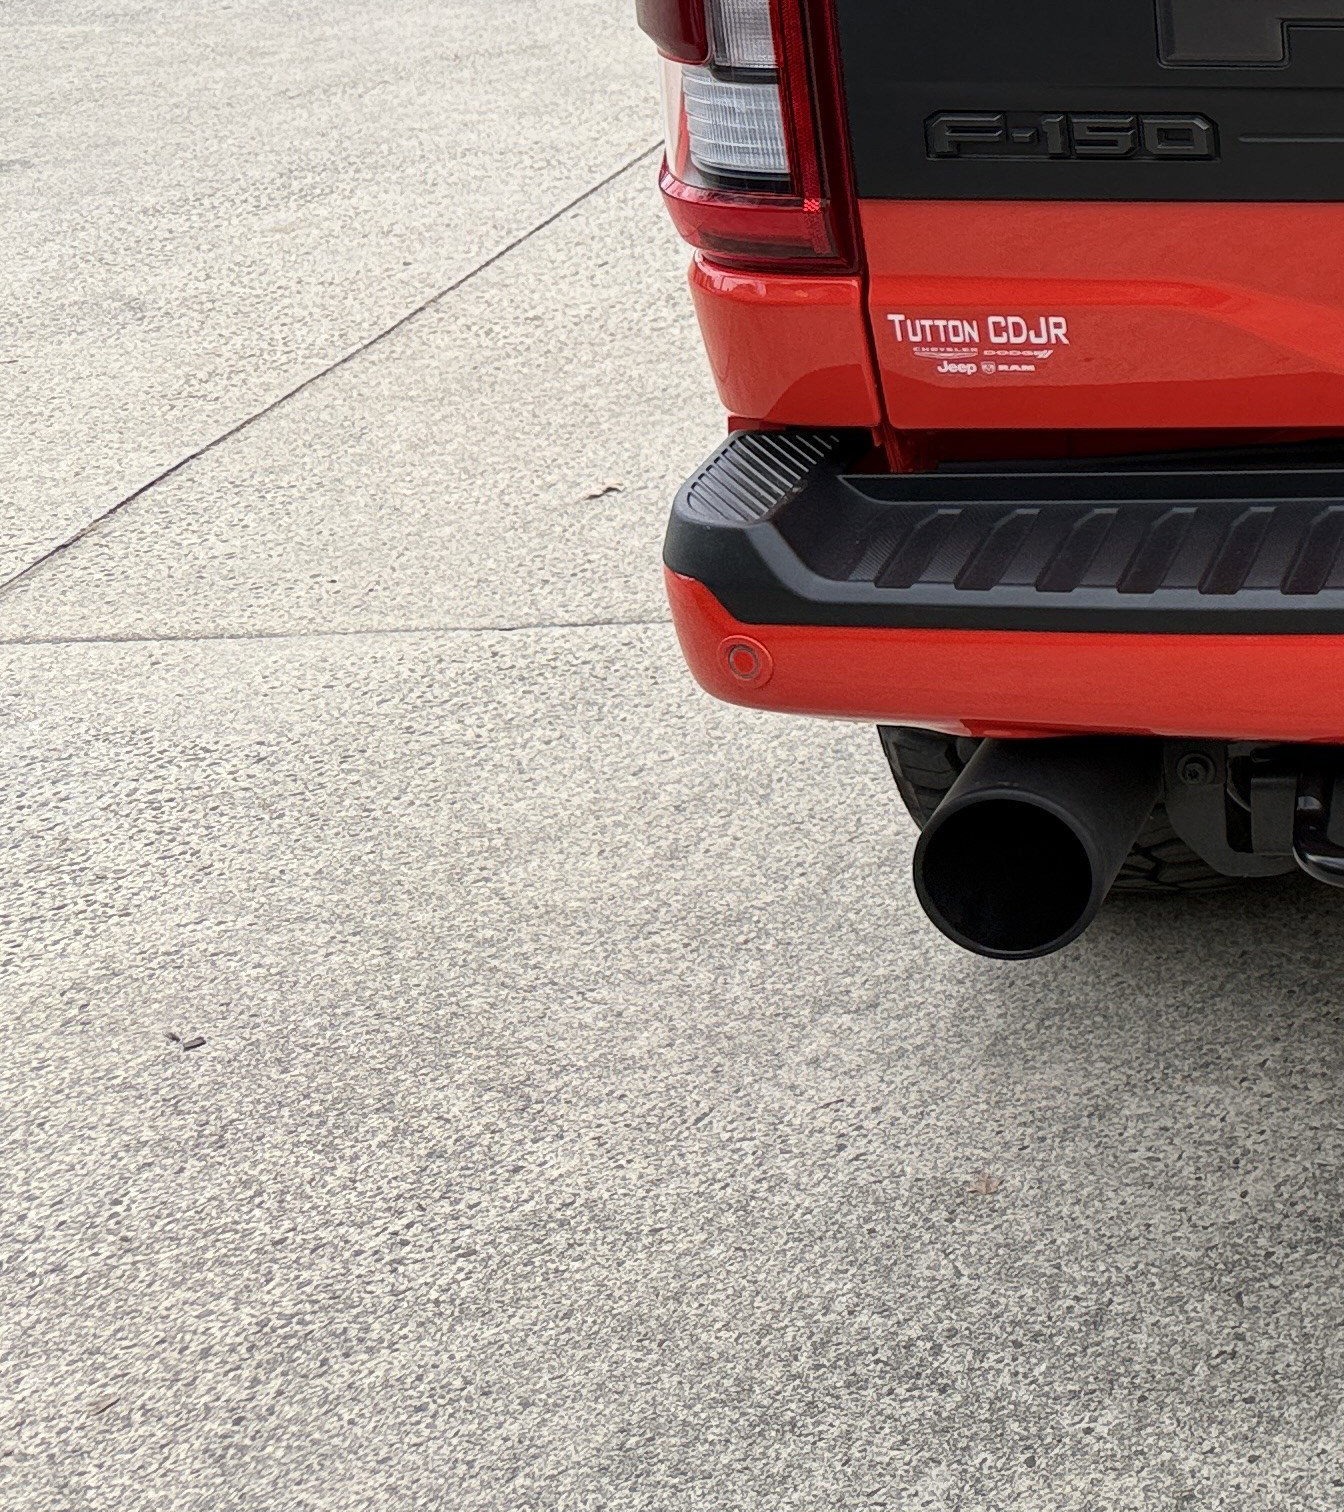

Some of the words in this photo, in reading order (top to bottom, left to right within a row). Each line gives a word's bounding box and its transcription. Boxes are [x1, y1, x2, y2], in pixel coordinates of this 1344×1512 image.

[924, 110, 1220, 161] F-150
[887, 313, 980, 343] TUTTON
[987, 315, 1070, 345] CDJR
[937, 360, 978, 375] Jeep
[998, 364, 1036, 372] RAM
